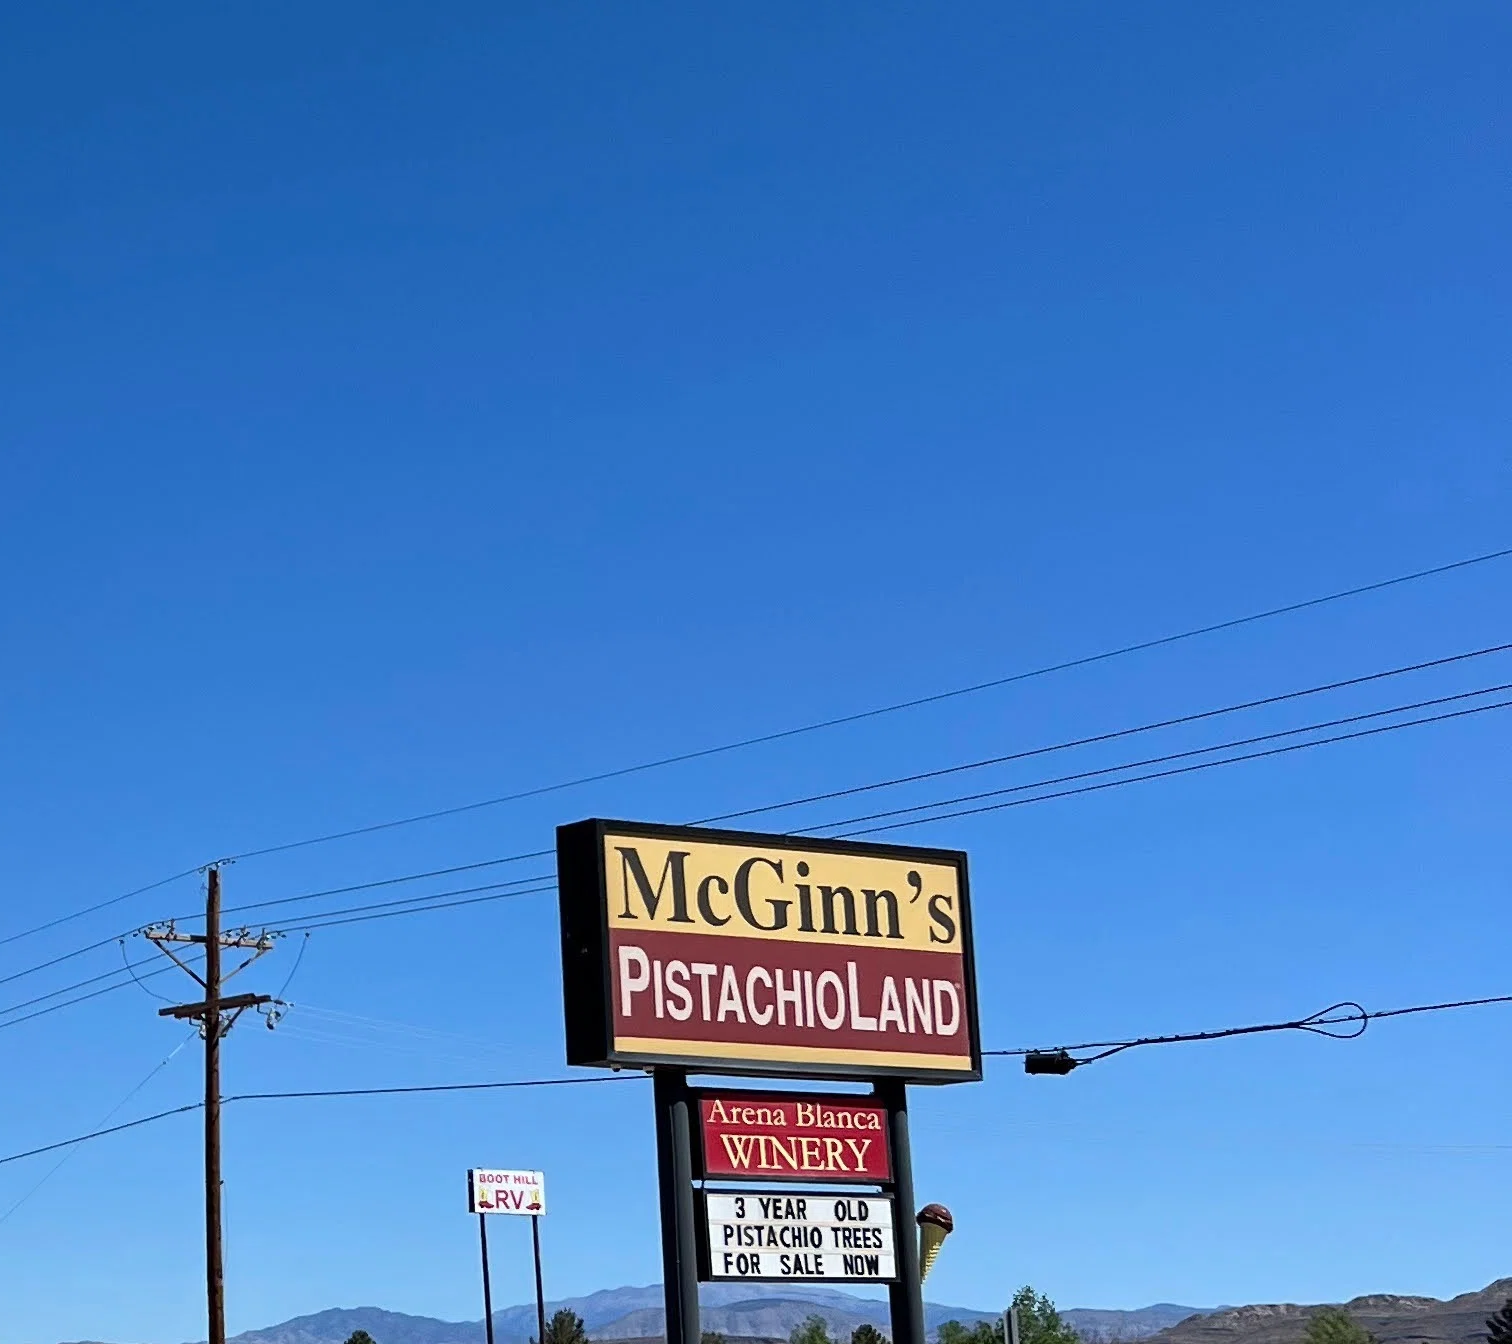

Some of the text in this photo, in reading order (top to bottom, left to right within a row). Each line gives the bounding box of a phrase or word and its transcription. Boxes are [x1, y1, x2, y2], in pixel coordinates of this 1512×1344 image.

[614, 846, 956, 944] McGinn's
[707, 1099, 881, 1130] Arena Blanca
[720, 1134, 872, 1172] WINERY
[479, 1173, 538, 1185] BOOT HILL
[495, 1189, 524, 1210] RV
[735, 1197, 869, 1221] 3 YEAR OLD
[723, 1225, 882, 1249] PISTACHIO TREES
[724, 1253, 879, 1276] FOR SALE NOW
